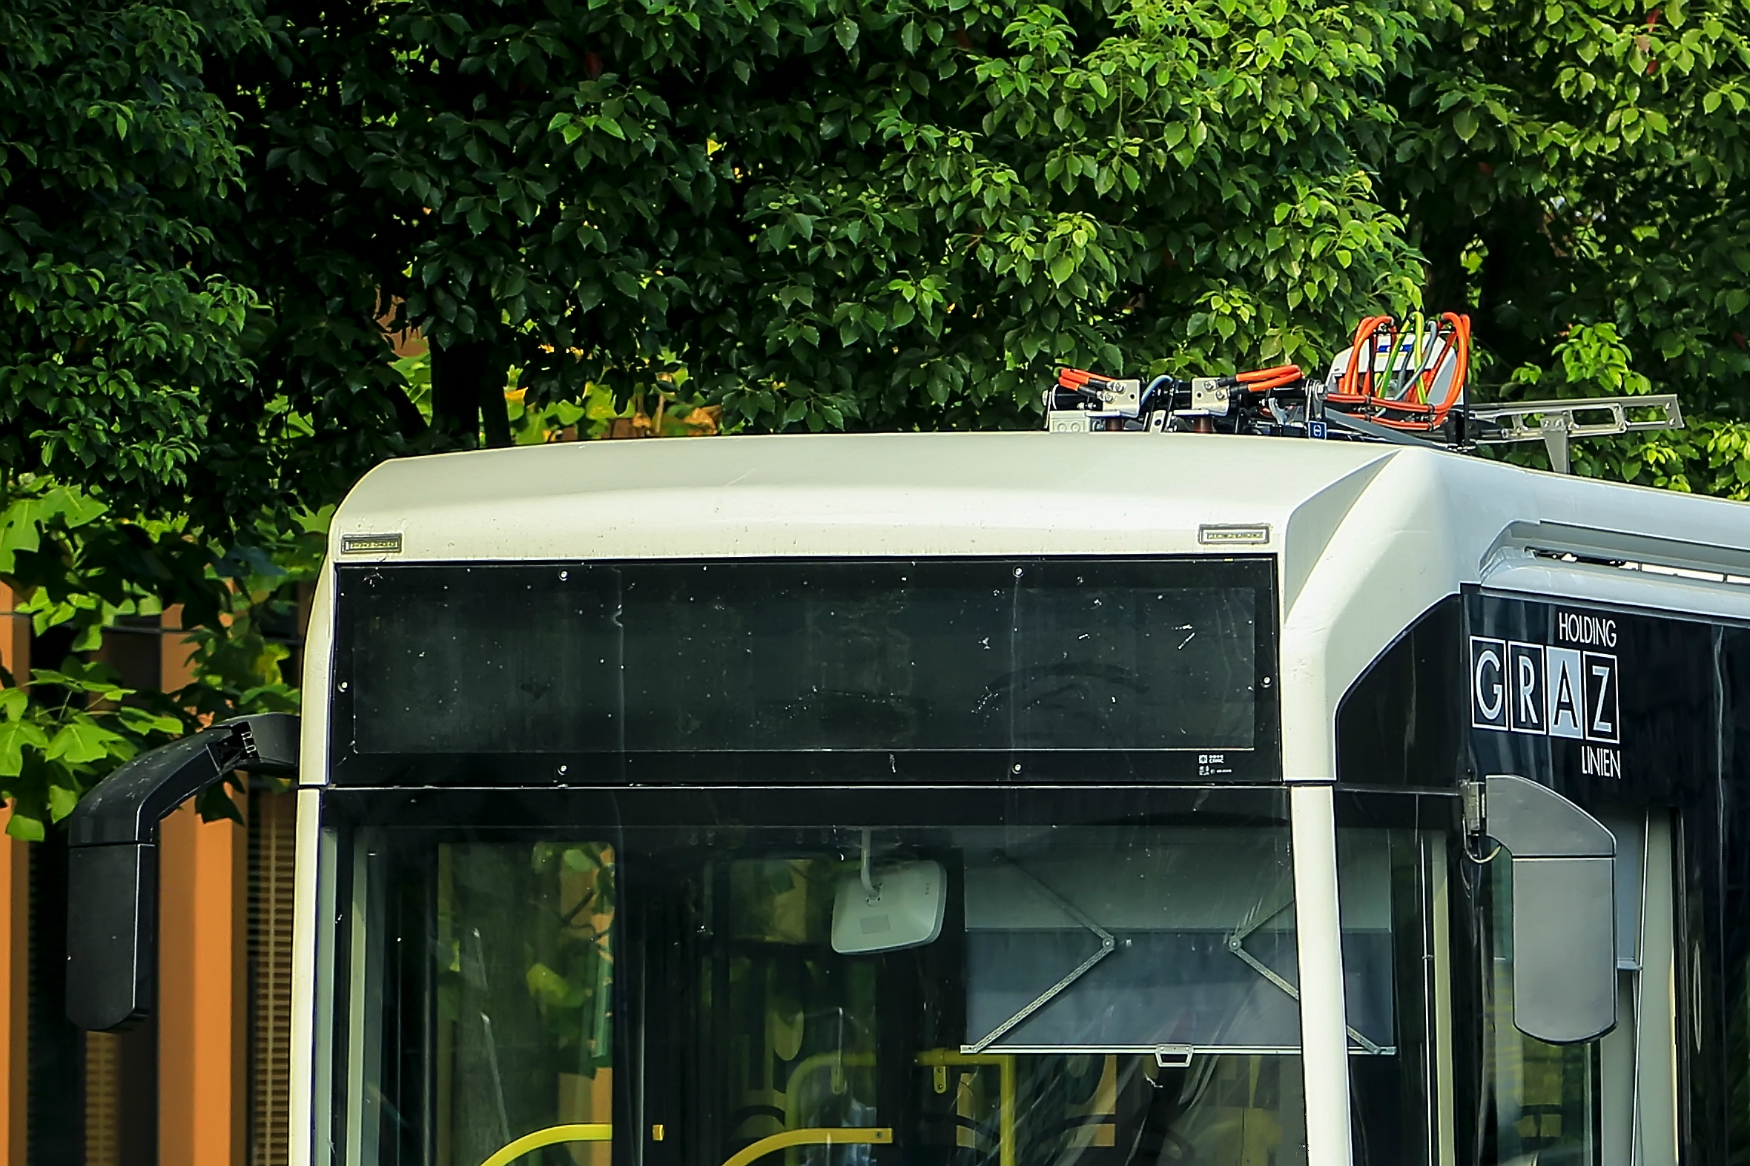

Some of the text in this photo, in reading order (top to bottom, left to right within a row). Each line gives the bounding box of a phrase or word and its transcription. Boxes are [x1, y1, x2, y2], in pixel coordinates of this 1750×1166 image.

[1558, 612, 1617, 648] HOLDING
[1475, 650, 1613, 733] GRAZ
[1581, 746, 1621, 779] LINIEN
